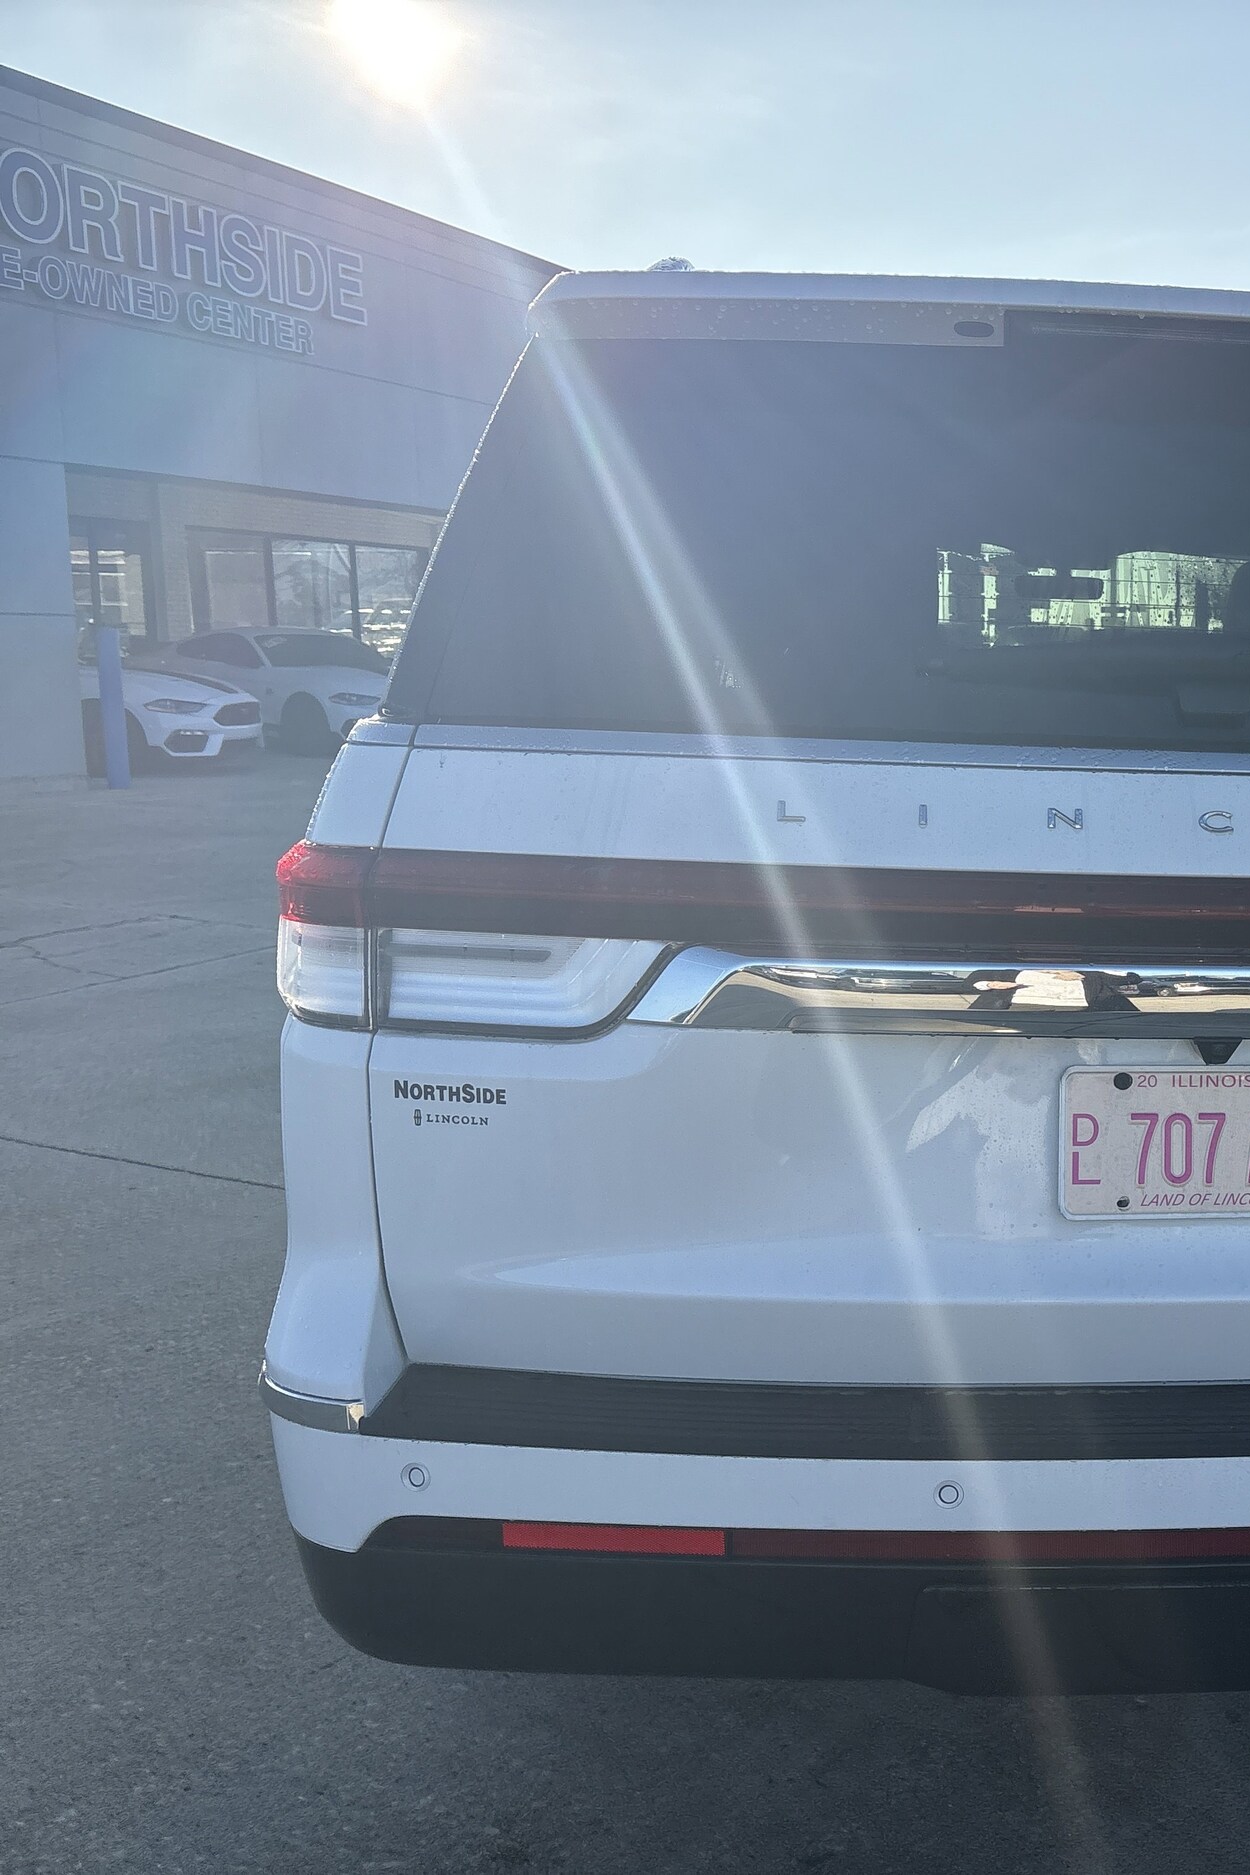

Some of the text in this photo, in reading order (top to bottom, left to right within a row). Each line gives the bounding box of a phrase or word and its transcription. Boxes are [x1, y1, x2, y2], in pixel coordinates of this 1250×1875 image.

[0, 147, 368, 327] ORTHSIDE
[187, 291, 315, 356] CENTER
[1137, 1075, 1158, 1088] 20
[426, 1113, 489, 1126] LINCOLN
[1130, 1112, 1226, 1185] 707
[1140, 1194, 1186, 1207] LAND
[1188, 1193, 1210, 1207] OF
